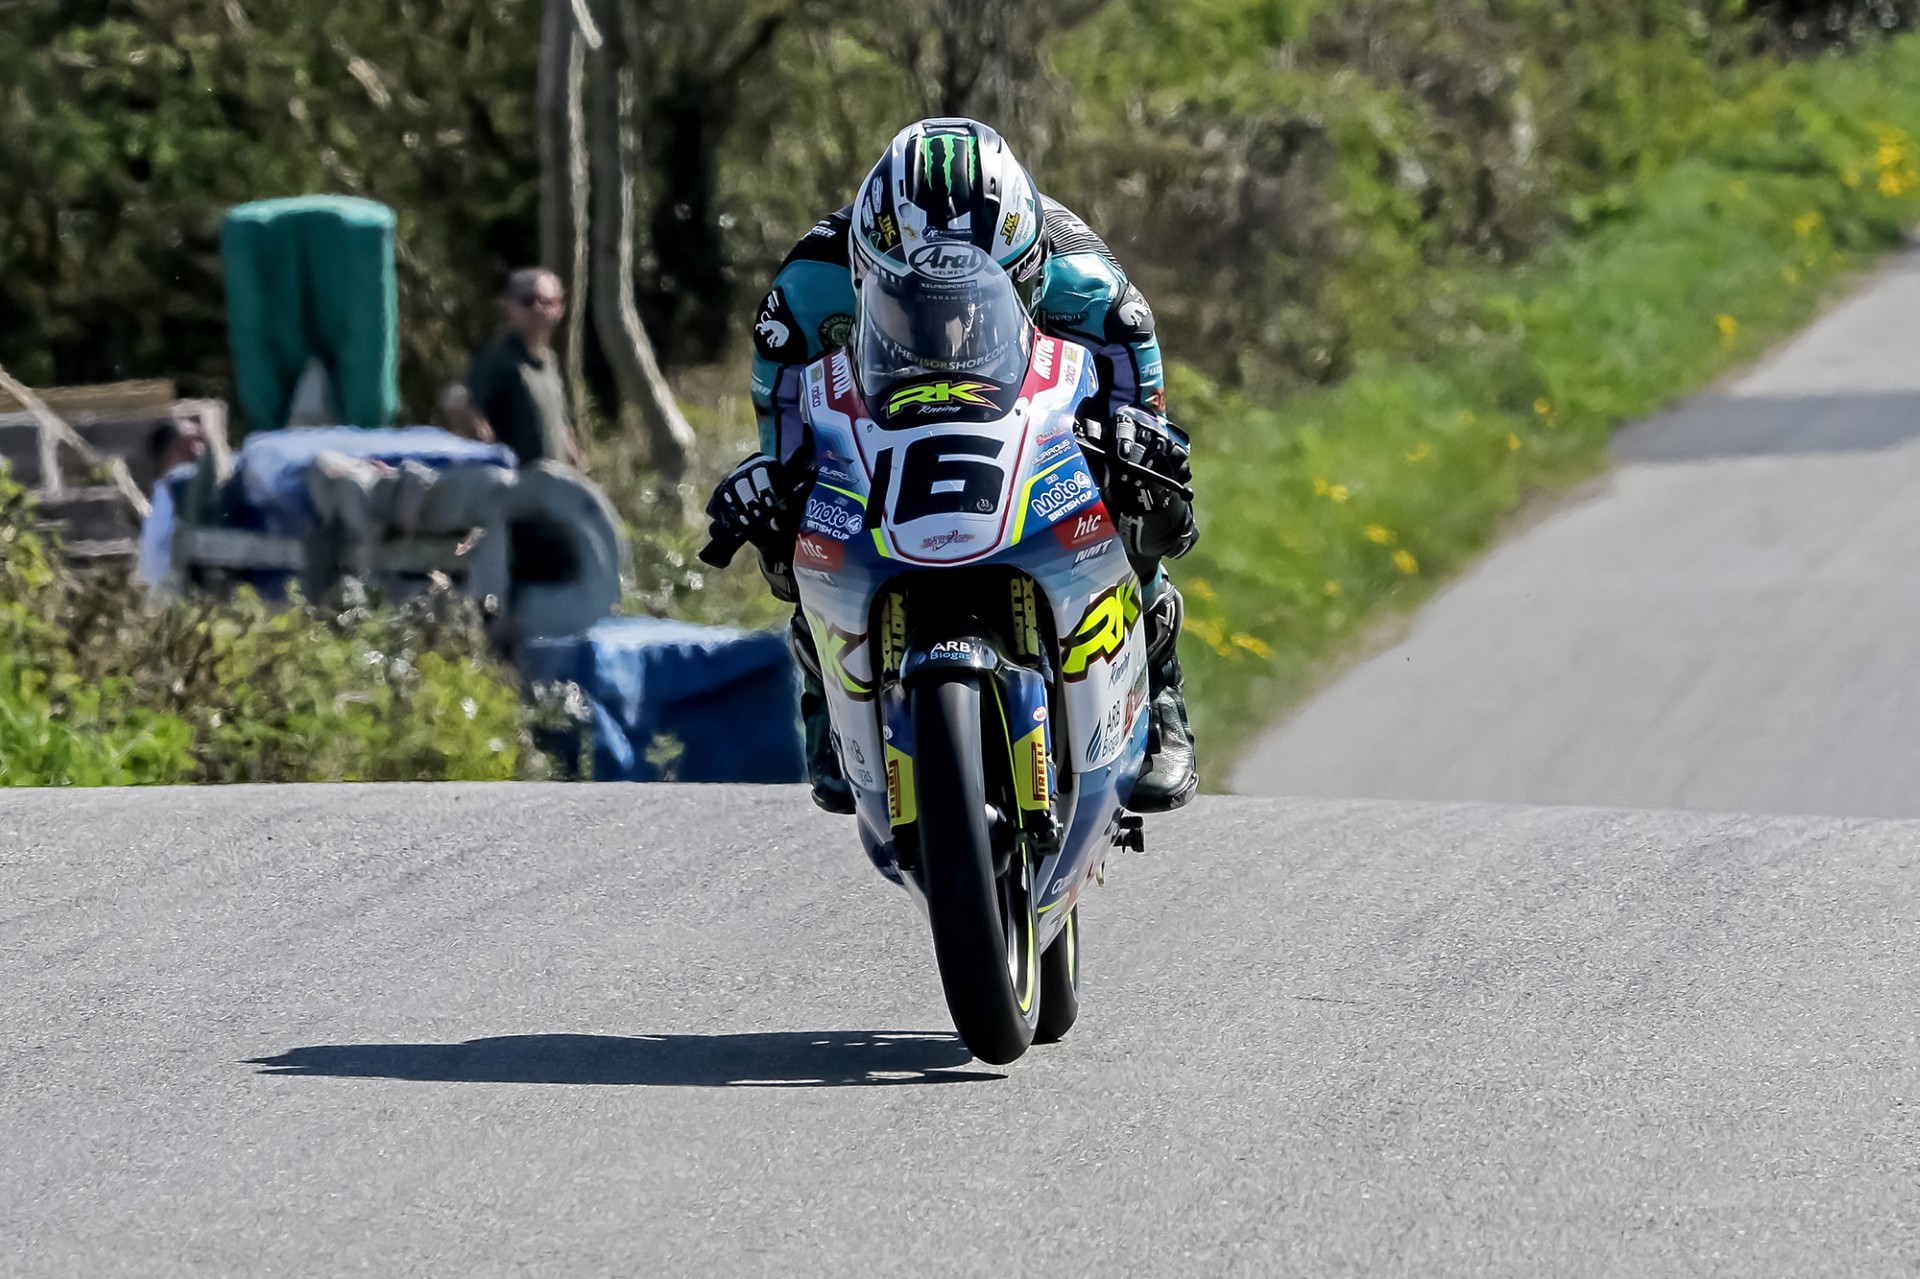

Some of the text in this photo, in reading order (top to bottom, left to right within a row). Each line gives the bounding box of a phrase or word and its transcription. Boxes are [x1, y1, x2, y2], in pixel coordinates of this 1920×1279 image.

[915, 246, 979, 269] Arai
[1032, 337, 1056, 381] MOTUL
[885, 381, 996, 416] RK
[917, 405, 962, 415] Racing
[1031, 438, 1071, 465] BURROWS
[863, 434, 1005, 529] 16
[1031, 470, 1091, 517] Moto4
[806, 499, 863, 534] Moto4
[1047, 490, 1093, 522] BRITISH CUP
[831, 529, 850, 541] CUP
[1074, 514, 1102, 539] htc
[1074, 539, 1113, 564] NMT
[1061, 575, 1140, 678] RK
[930, 651, 972, 661] Biogas
[931, 640, 971, 653] ARB
[1105, 699, 1121, 737] ARB
[1031, 741, 1047, 801] PIRELLI
